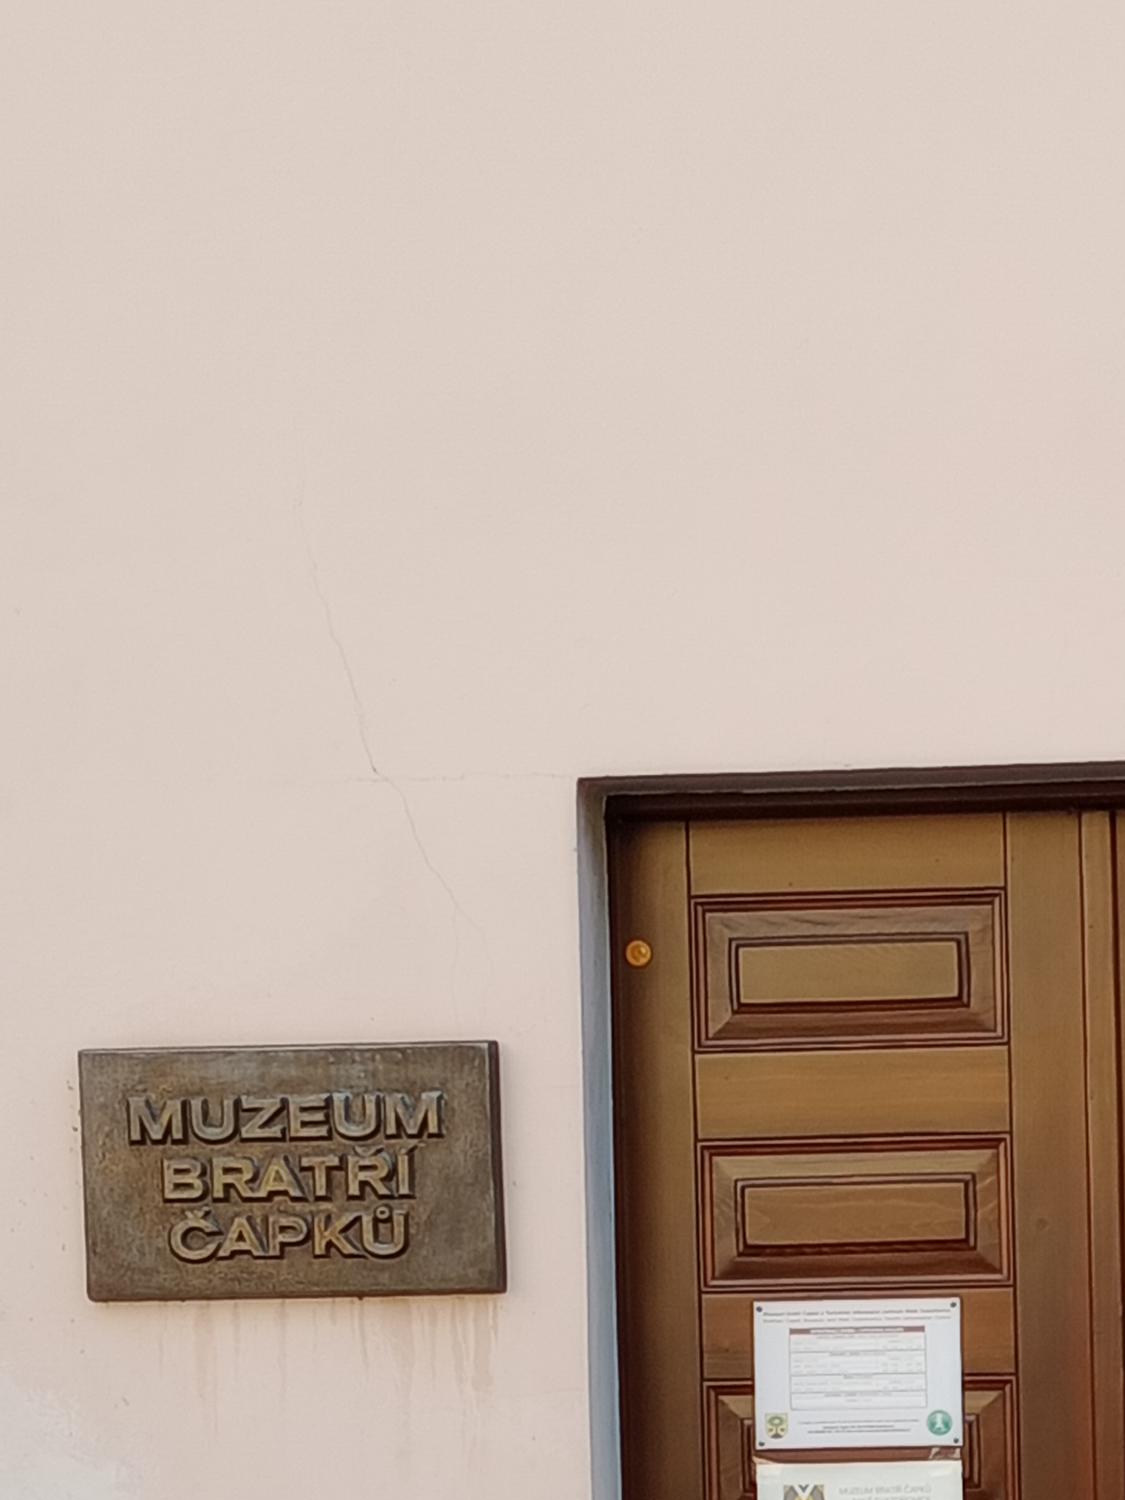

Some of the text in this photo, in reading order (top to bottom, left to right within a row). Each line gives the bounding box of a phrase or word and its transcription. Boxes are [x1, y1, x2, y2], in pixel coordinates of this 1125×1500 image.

[127, 1089, 446, 1145] MUZEUM
[162, 1142, 425, 1203] BRATŘÍ
[169, 1204, 410, 1262] ČAPKŮ
